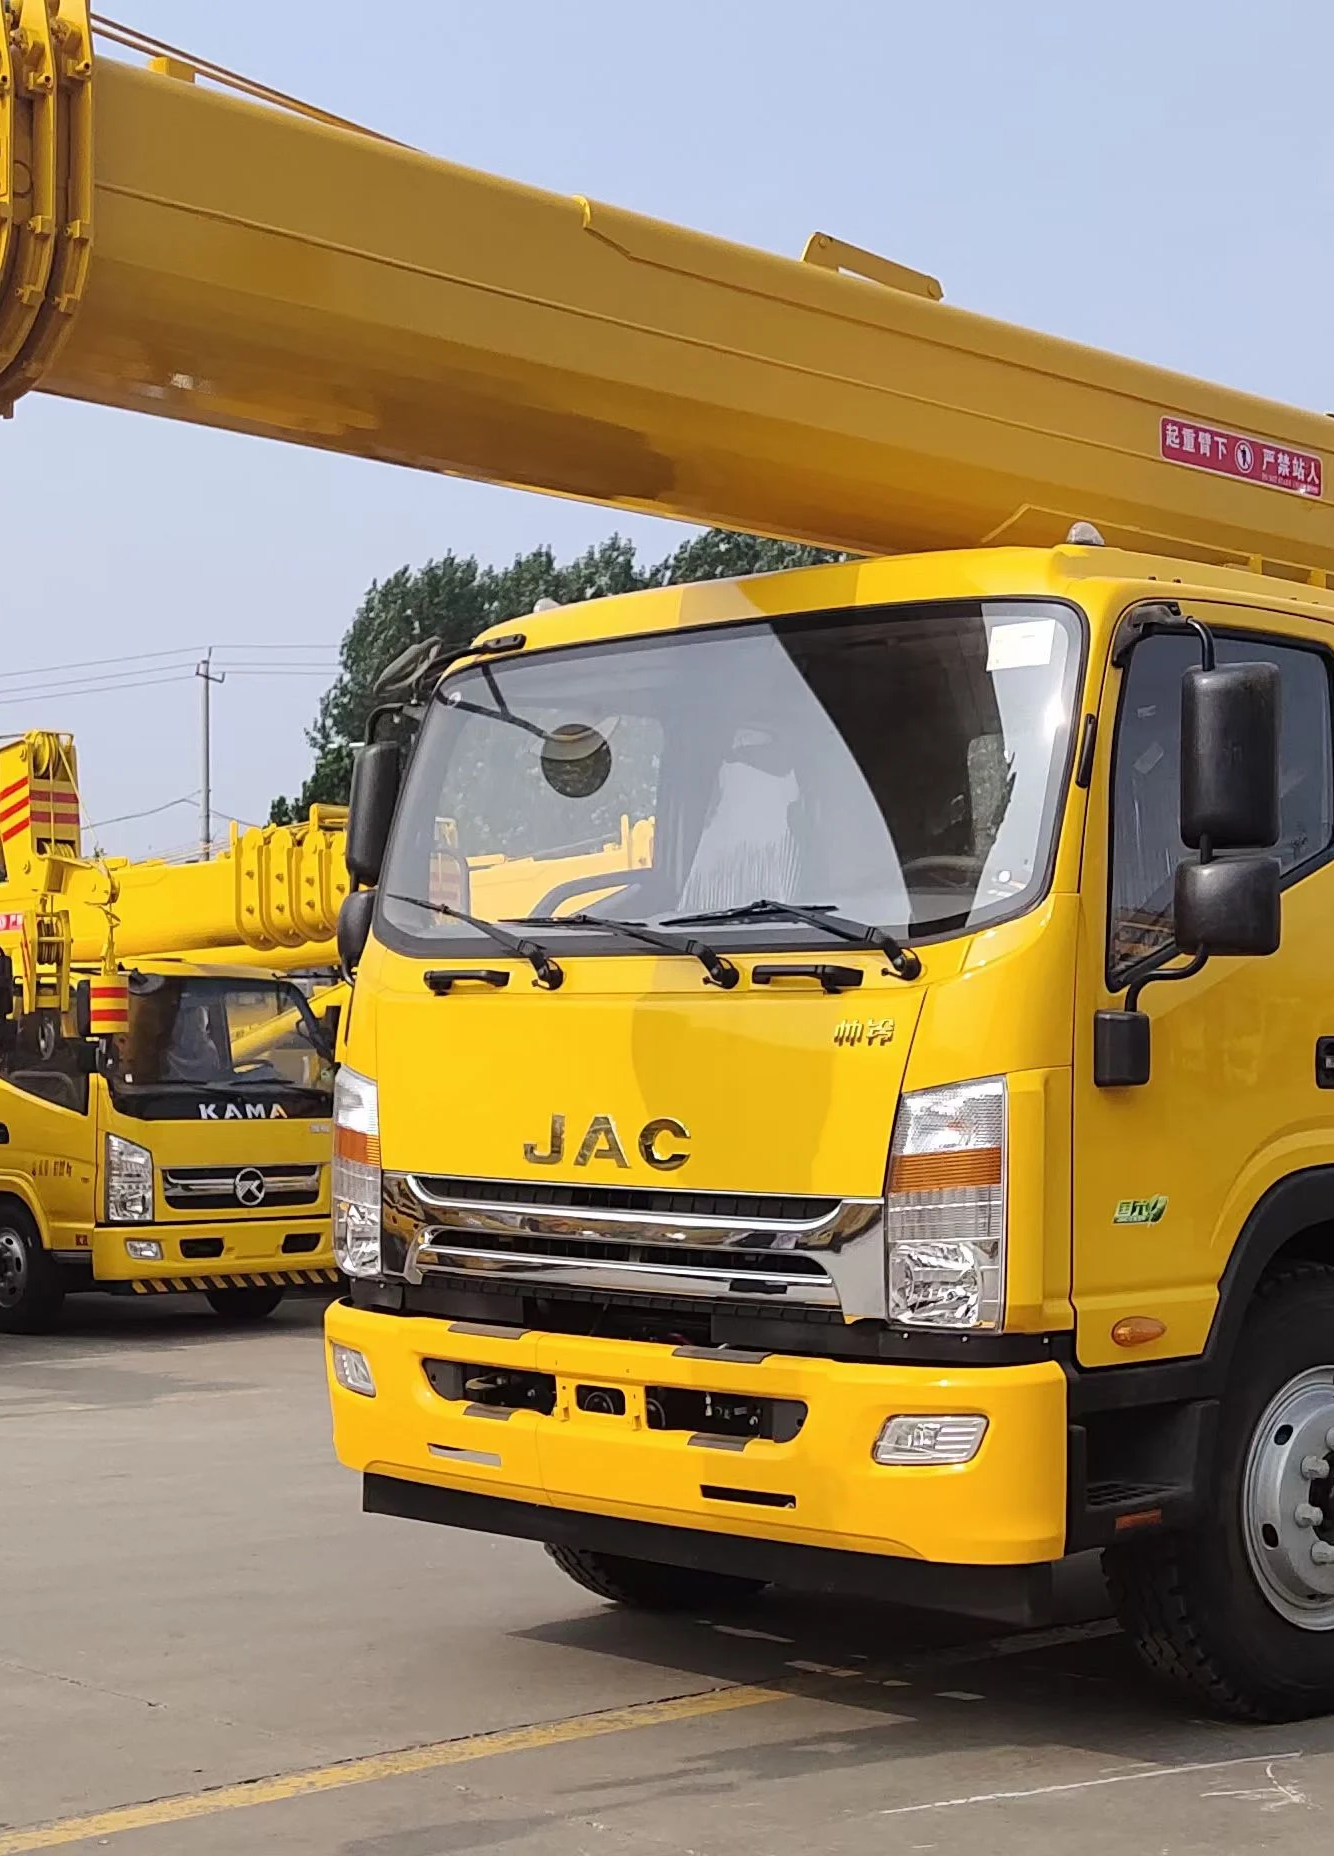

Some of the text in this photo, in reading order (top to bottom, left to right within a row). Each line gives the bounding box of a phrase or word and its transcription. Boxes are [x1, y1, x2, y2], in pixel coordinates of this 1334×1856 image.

[1165, 423, 1228, 460] 起重臂下
[1262, 448, 1320, 485] 严禁站人
[198, 1103, 288, 1120] KAMA
[523, 1112, 692, 1172] JAC
